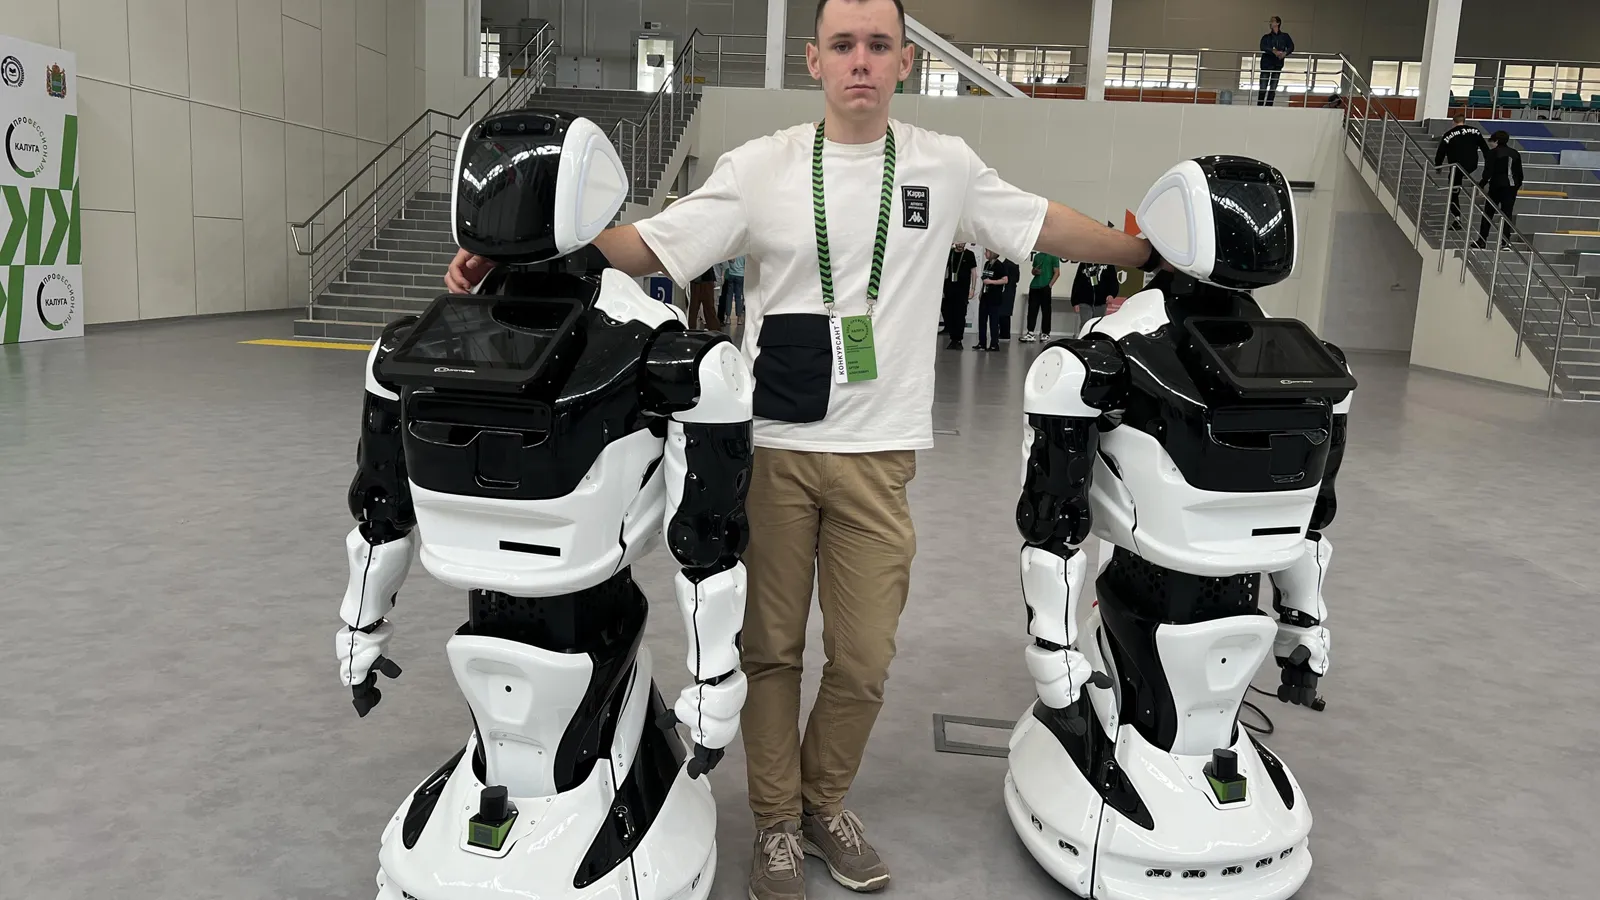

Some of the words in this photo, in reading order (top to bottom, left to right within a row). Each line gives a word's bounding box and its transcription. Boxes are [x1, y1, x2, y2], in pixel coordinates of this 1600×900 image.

[13, 116, 48, 175] ПРОФЕССИОНАЛЫ
[14, 142, 40, 153] КАЛУГА
[906, 190, 925, 199] Kappa
[43, 273, 75, 327] ПРОФЕССИОНАЛЫ
[45, 298, 68, 307] КАЛУГА
[833, 325, 845, 376] КОНКУРСАНТ
